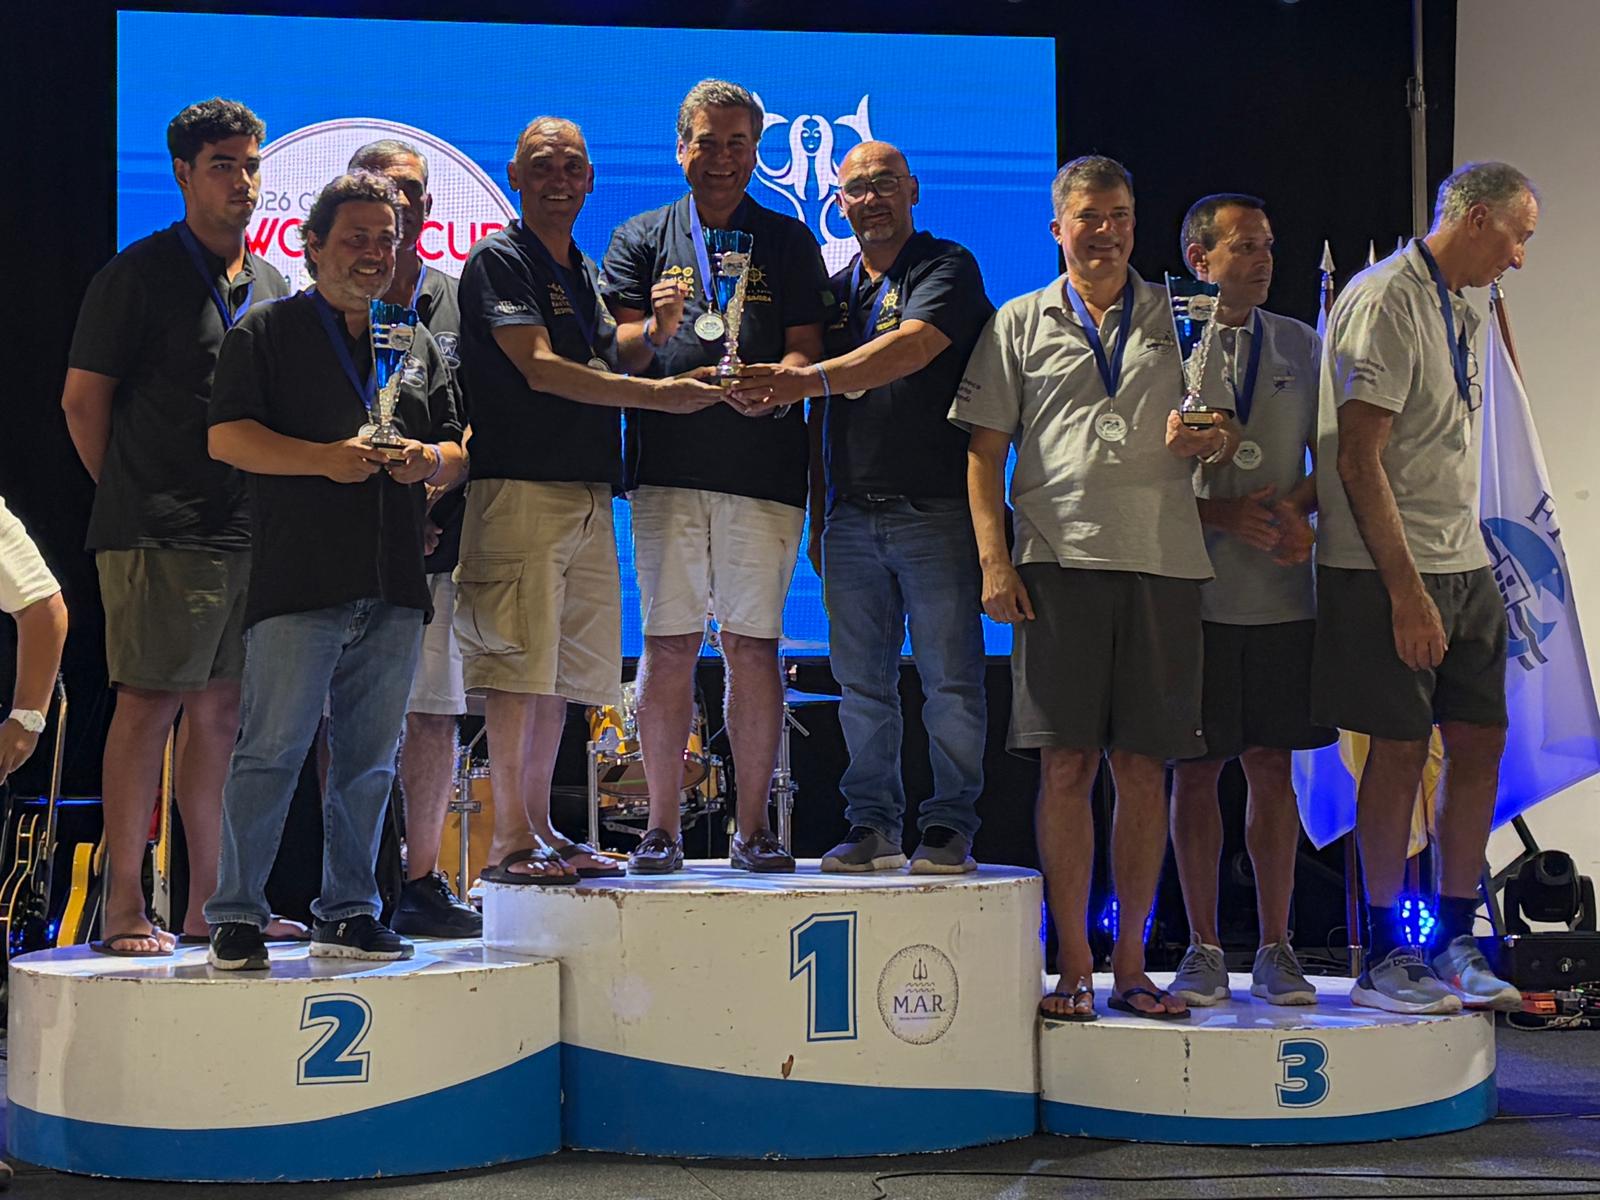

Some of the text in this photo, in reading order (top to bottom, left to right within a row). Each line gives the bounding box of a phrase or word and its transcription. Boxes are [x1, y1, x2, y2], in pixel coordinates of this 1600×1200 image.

[256, 191, 292, 212] 026
[790, 910, 858, 1042] 1
[893, 994, 947, 1014] M.A.R.
[296, 993, 373, 1086] 2
[1274, 1037, 1331, 1109] 3
